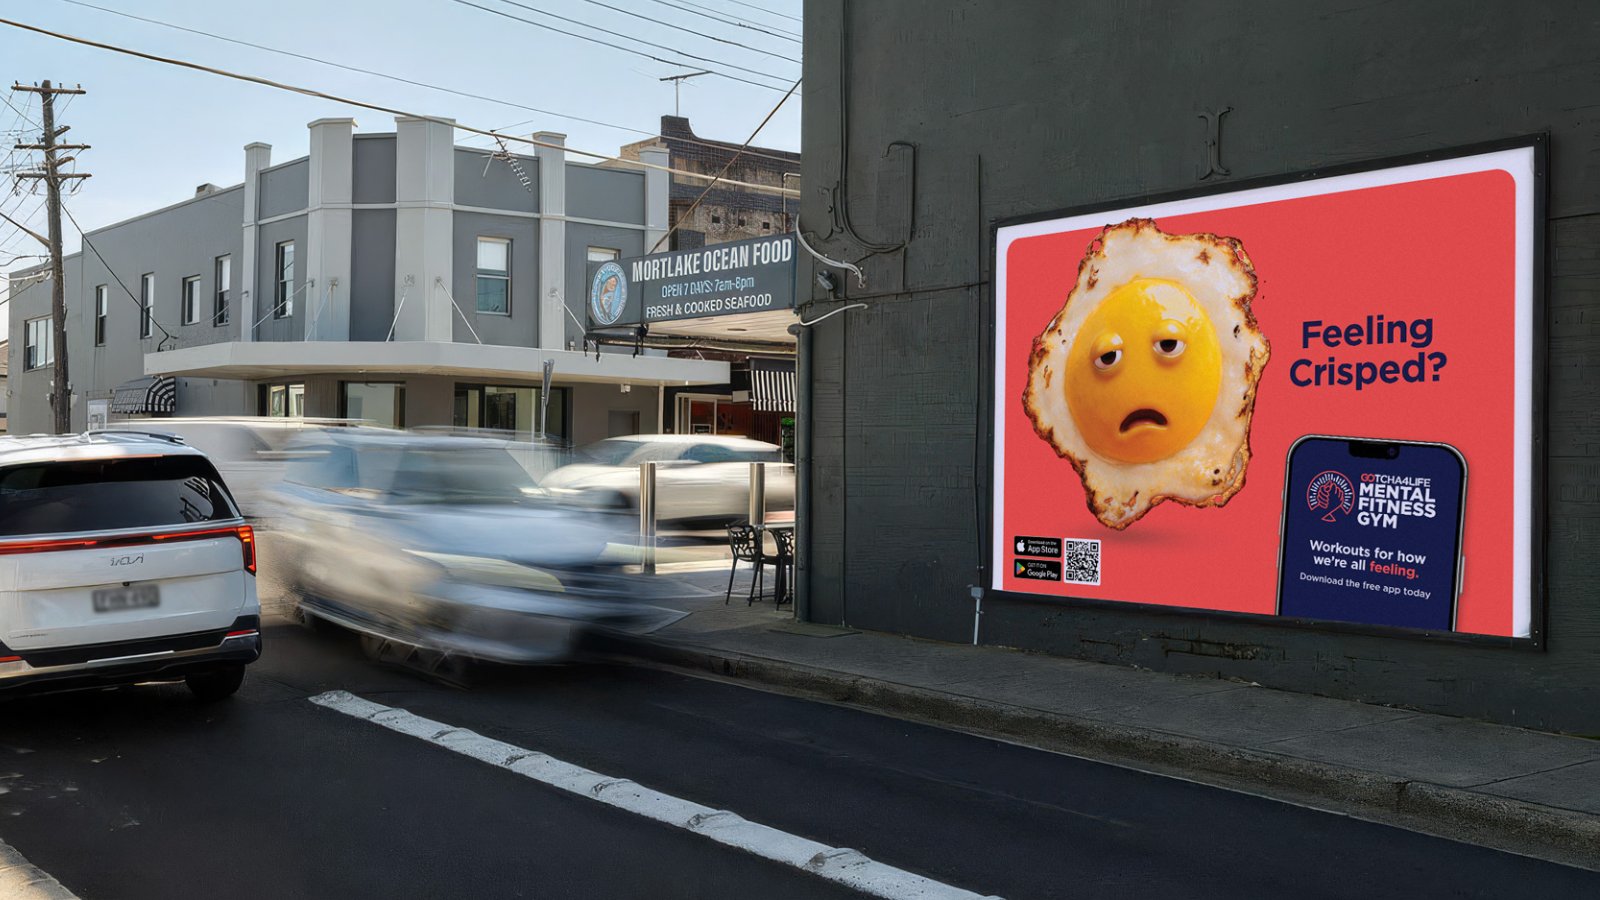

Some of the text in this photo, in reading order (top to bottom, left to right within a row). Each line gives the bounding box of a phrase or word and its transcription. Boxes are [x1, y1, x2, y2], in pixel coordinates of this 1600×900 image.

[632, 239, 792, 282] MORTLAKE OCEAN FOOD
[662, 283, 682, 298] OPEN
[684, 283, 689, 295] 7
[714, 277, 755, 293] 7am-8pm
[646, 293, 772, 318] FRESH & COOKED SEAFOOD
[1302, 314, 1433, 349] Feeling
[1289, 352, 1447, 391] Crisped?
[1360, 473, 1431, 487] GOTCHA4LIFE
[1359, 482, 1436, 503] MENTAL
[1358, 497, 1437, 518] FITNESS
[1357, 511, 1398, 529] GYM
[1027, 545, 1059, 554] App Store
[1310, 539, 1426, 564] Workouts for how
[1026, 568, 1058, 579] Google Play
[1313, 555, 1419, 579] we're all feeling.
[1299, 572, 1431, 600] Download the free app today
